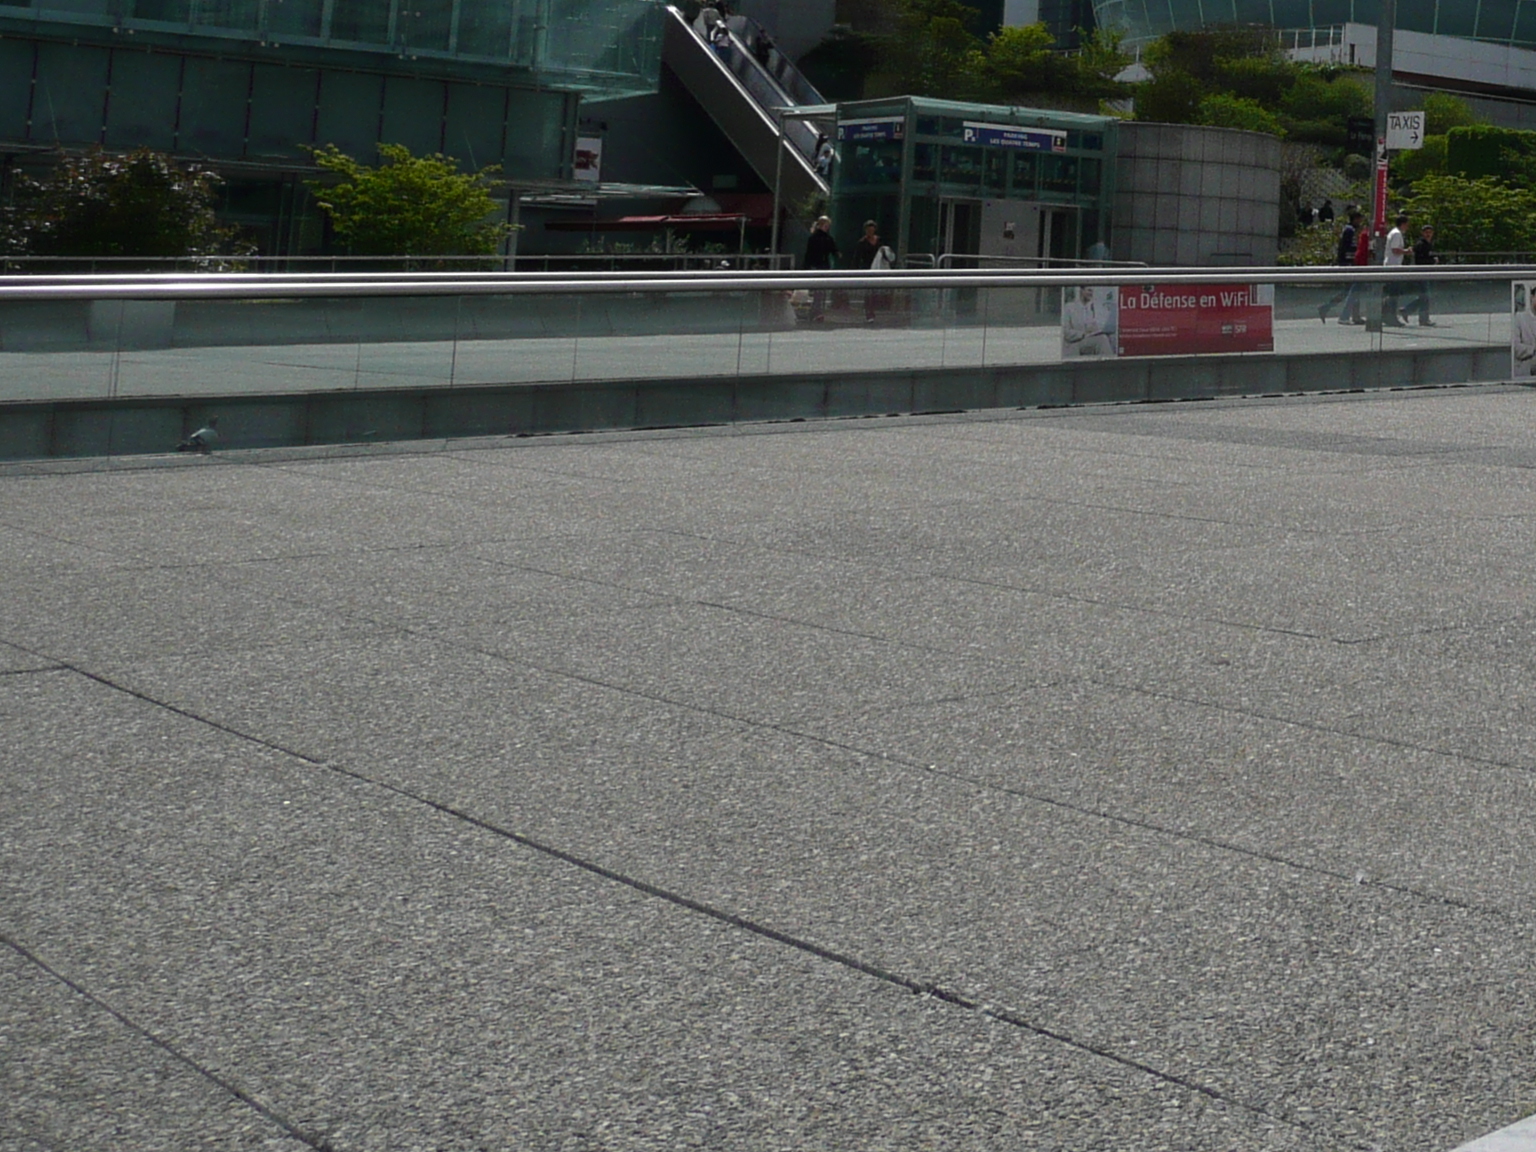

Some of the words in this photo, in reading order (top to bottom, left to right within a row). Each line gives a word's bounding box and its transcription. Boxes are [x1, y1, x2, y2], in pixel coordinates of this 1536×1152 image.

[1389, 115, 1421, 130] TAXIS
[1120, 293, 1136, 309] La
[1140, 292, 1196, 309] Défense
[1200, 294, 1216, 307] en
[1219, 291, 1248, 307] WiFi
